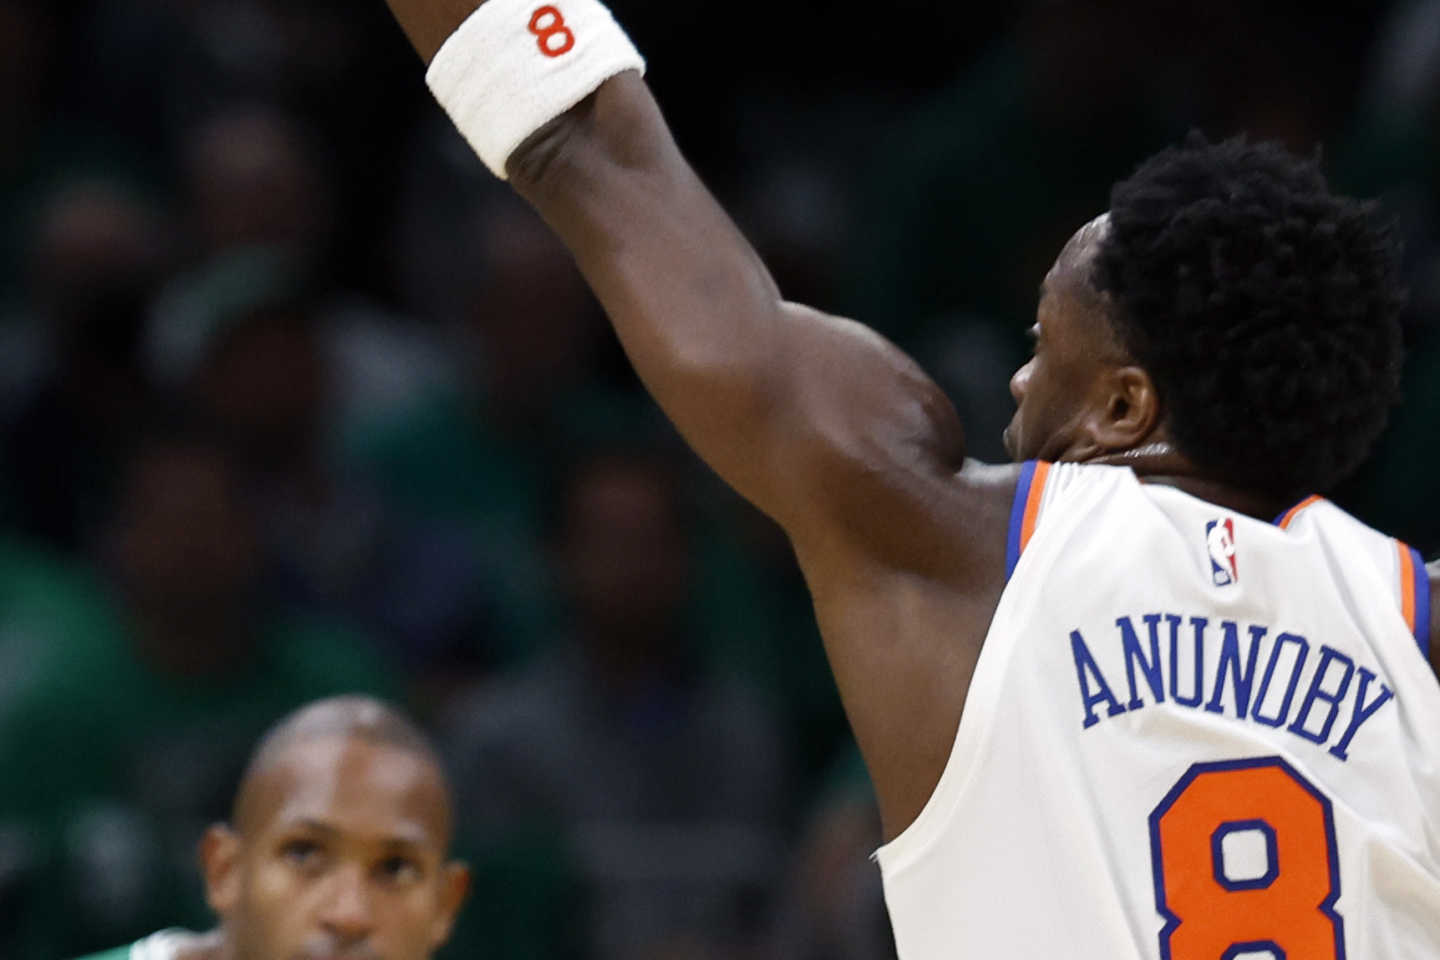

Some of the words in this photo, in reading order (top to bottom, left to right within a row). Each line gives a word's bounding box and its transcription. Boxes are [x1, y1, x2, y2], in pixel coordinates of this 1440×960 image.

[527, 4, 576, 58] 8
[1069, 612, 1394, 762] ANUNOBY
[1148, 755, 1346, 960] 8
